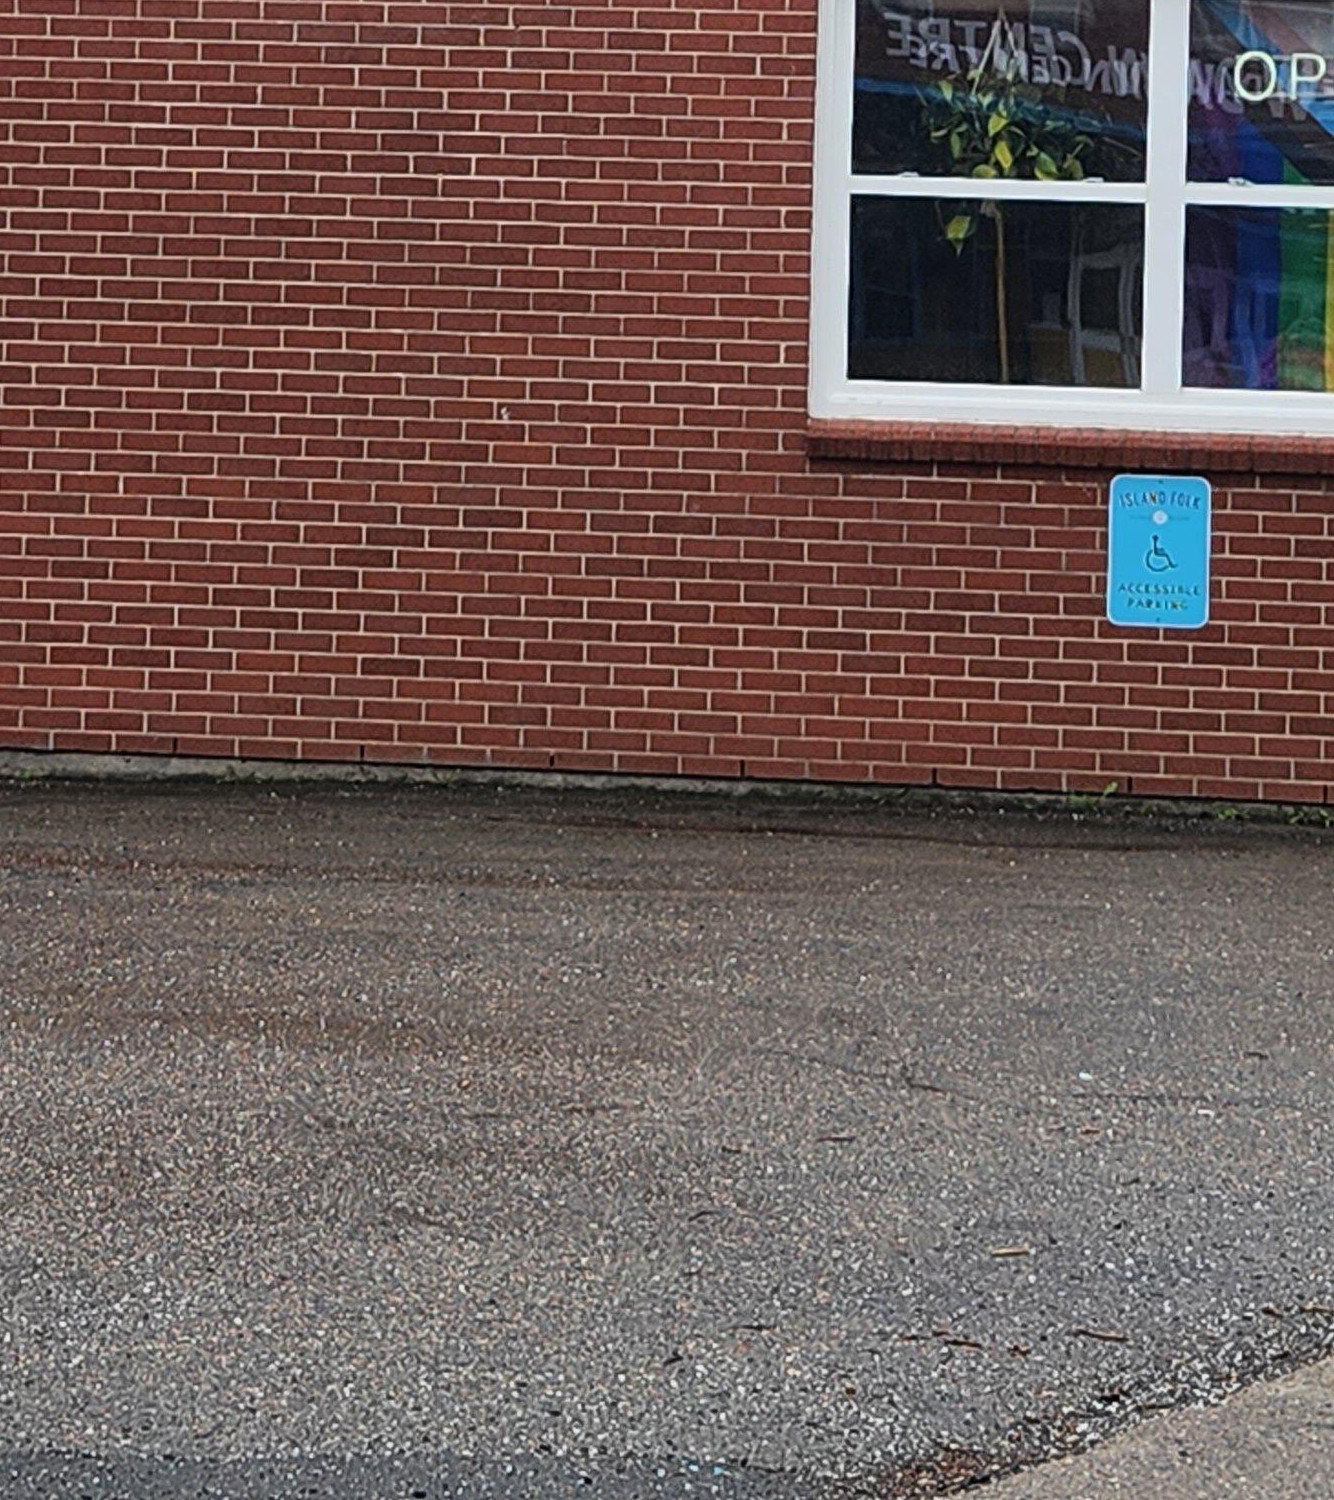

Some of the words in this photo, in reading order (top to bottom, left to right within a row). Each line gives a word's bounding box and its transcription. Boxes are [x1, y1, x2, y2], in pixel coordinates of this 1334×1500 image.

[1119, 490, 1165, 509] ISLAND
[1170, 491, 1200, 510] FOLK
[1117, 582, 1201, 596] ACCESSIBLE
[1126, 597, 1188, 611] PARKING
